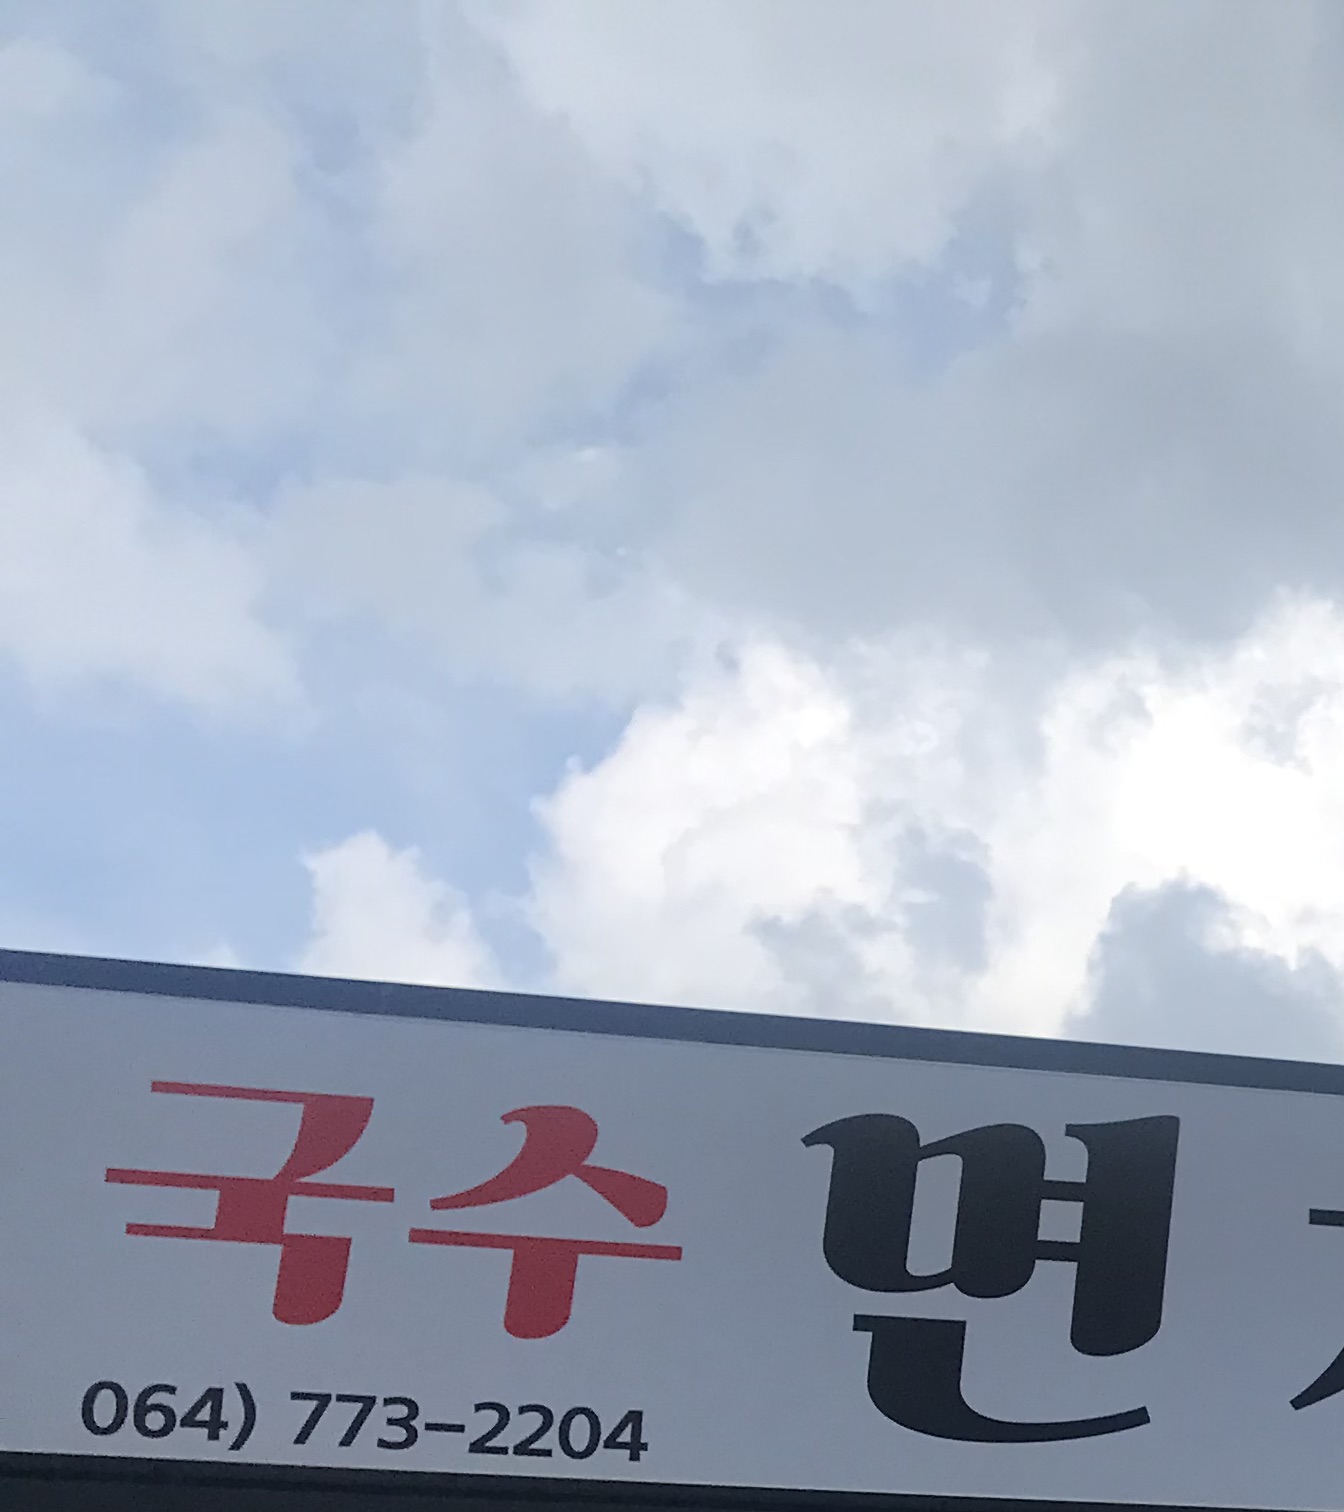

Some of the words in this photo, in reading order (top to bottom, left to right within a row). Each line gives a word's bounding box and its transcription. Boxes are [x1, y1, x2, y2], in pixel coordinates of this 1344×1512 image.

[106, 1081, 682, 1340] 국수
[79, 1380, 257, 1455] 064)
[288, 1390, 649, 1463] 773-2204
